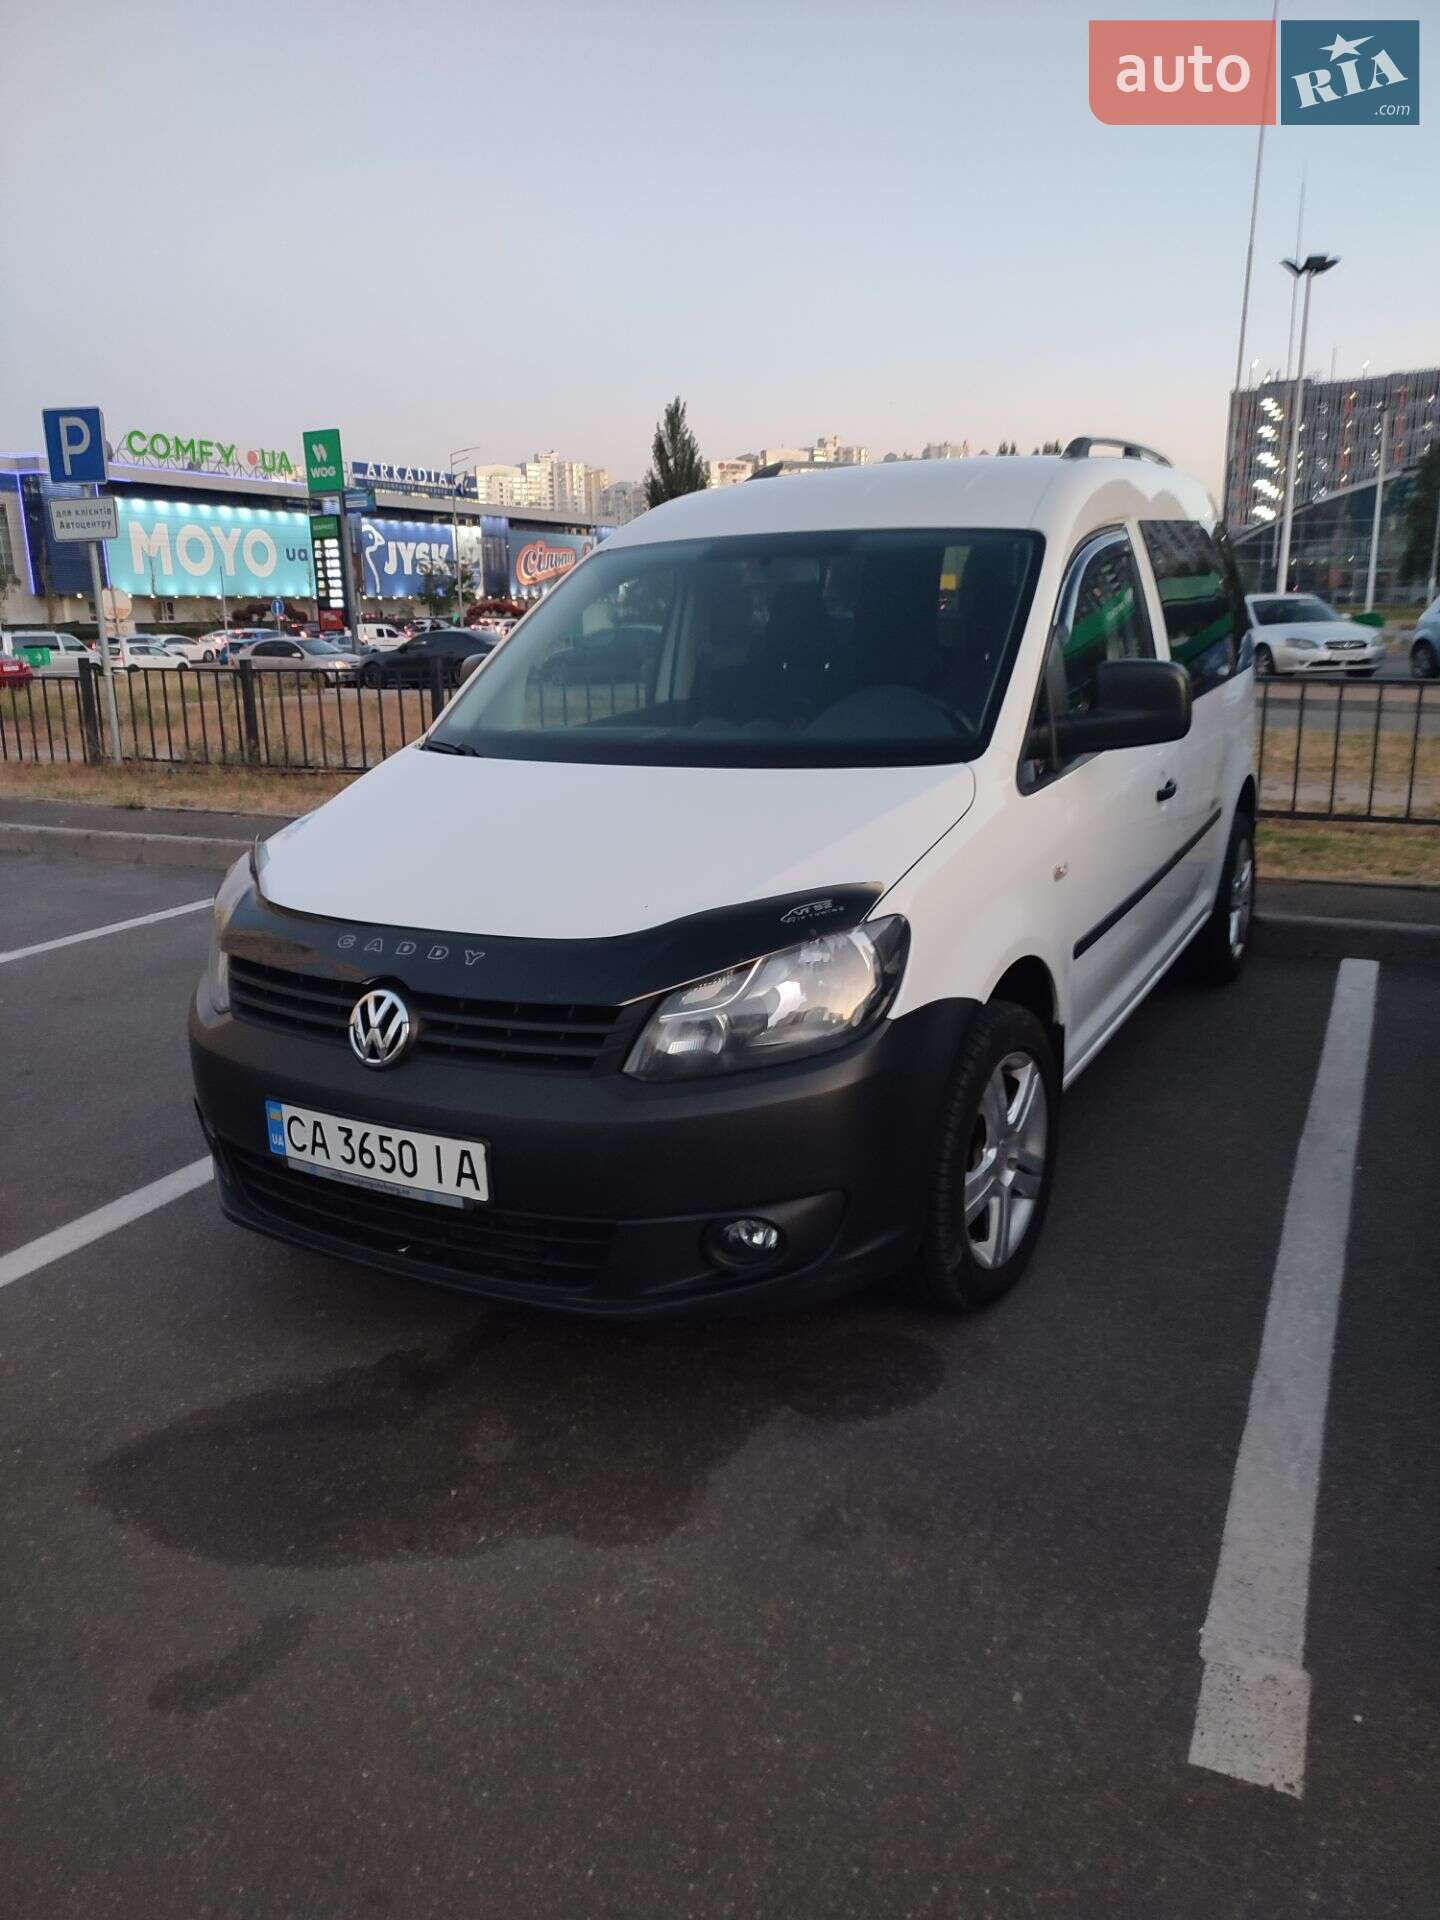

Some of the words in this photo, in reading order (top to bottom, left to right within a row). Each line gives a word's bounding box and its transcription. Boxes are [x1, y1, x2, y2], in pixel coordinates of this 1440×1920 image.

[59, 416, 91, 475] P
[127, 430, 236, 467] COMFY
[310, 465, 337, 479] WOG
[367, 462, 448, 486] ARKADIA
[128, 521, 278, 578] MOYO
[384, 541, 453, 576] JYSK
[337, 934, 486, 965] CADDY
[271, 1134, 285, 1147] UA
[287, 1115, 330, 1160] CA
[338, 1126, 418, 1178] 3650
